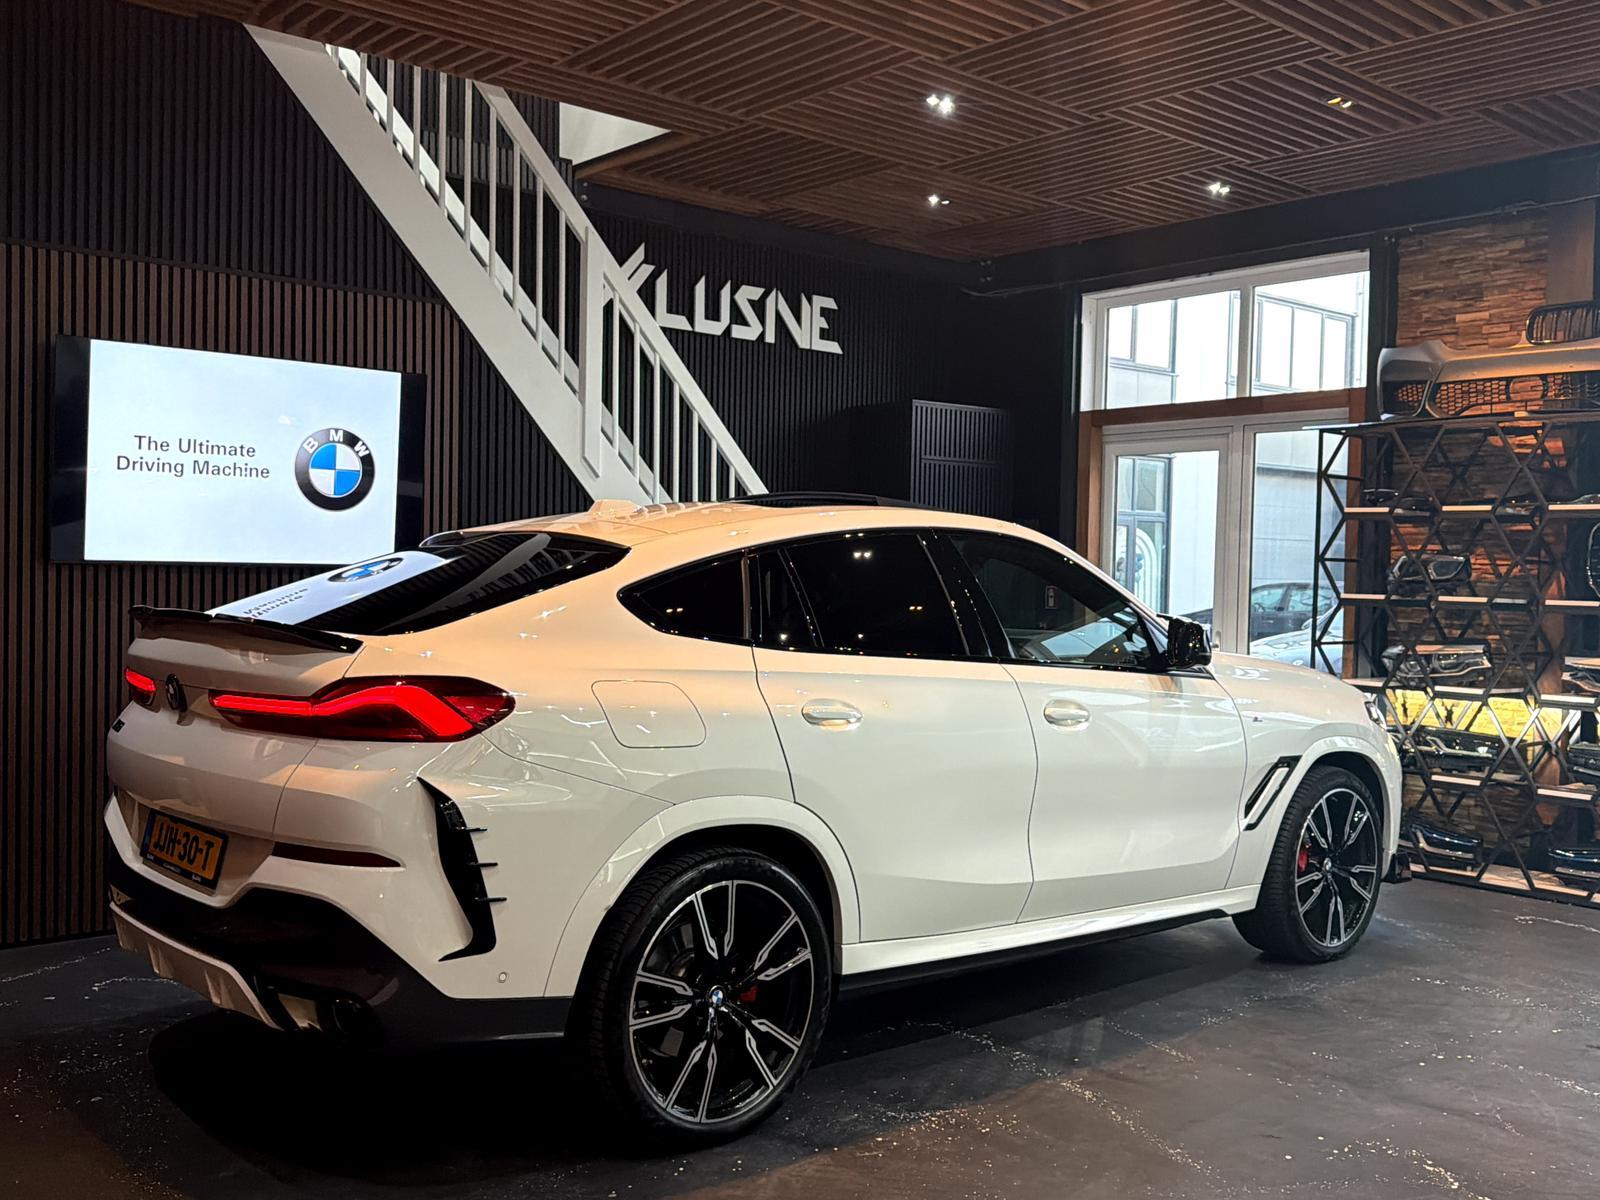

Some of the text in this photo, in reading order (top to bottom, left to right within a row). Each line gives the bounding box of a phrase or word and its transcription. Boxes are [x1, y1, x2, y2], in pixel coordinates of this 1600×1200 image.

[134, 435, 256, 457] The Ultimate
[303, 429, 370, 458] BMW
[116, 455, 270, 478] Driving Machine
